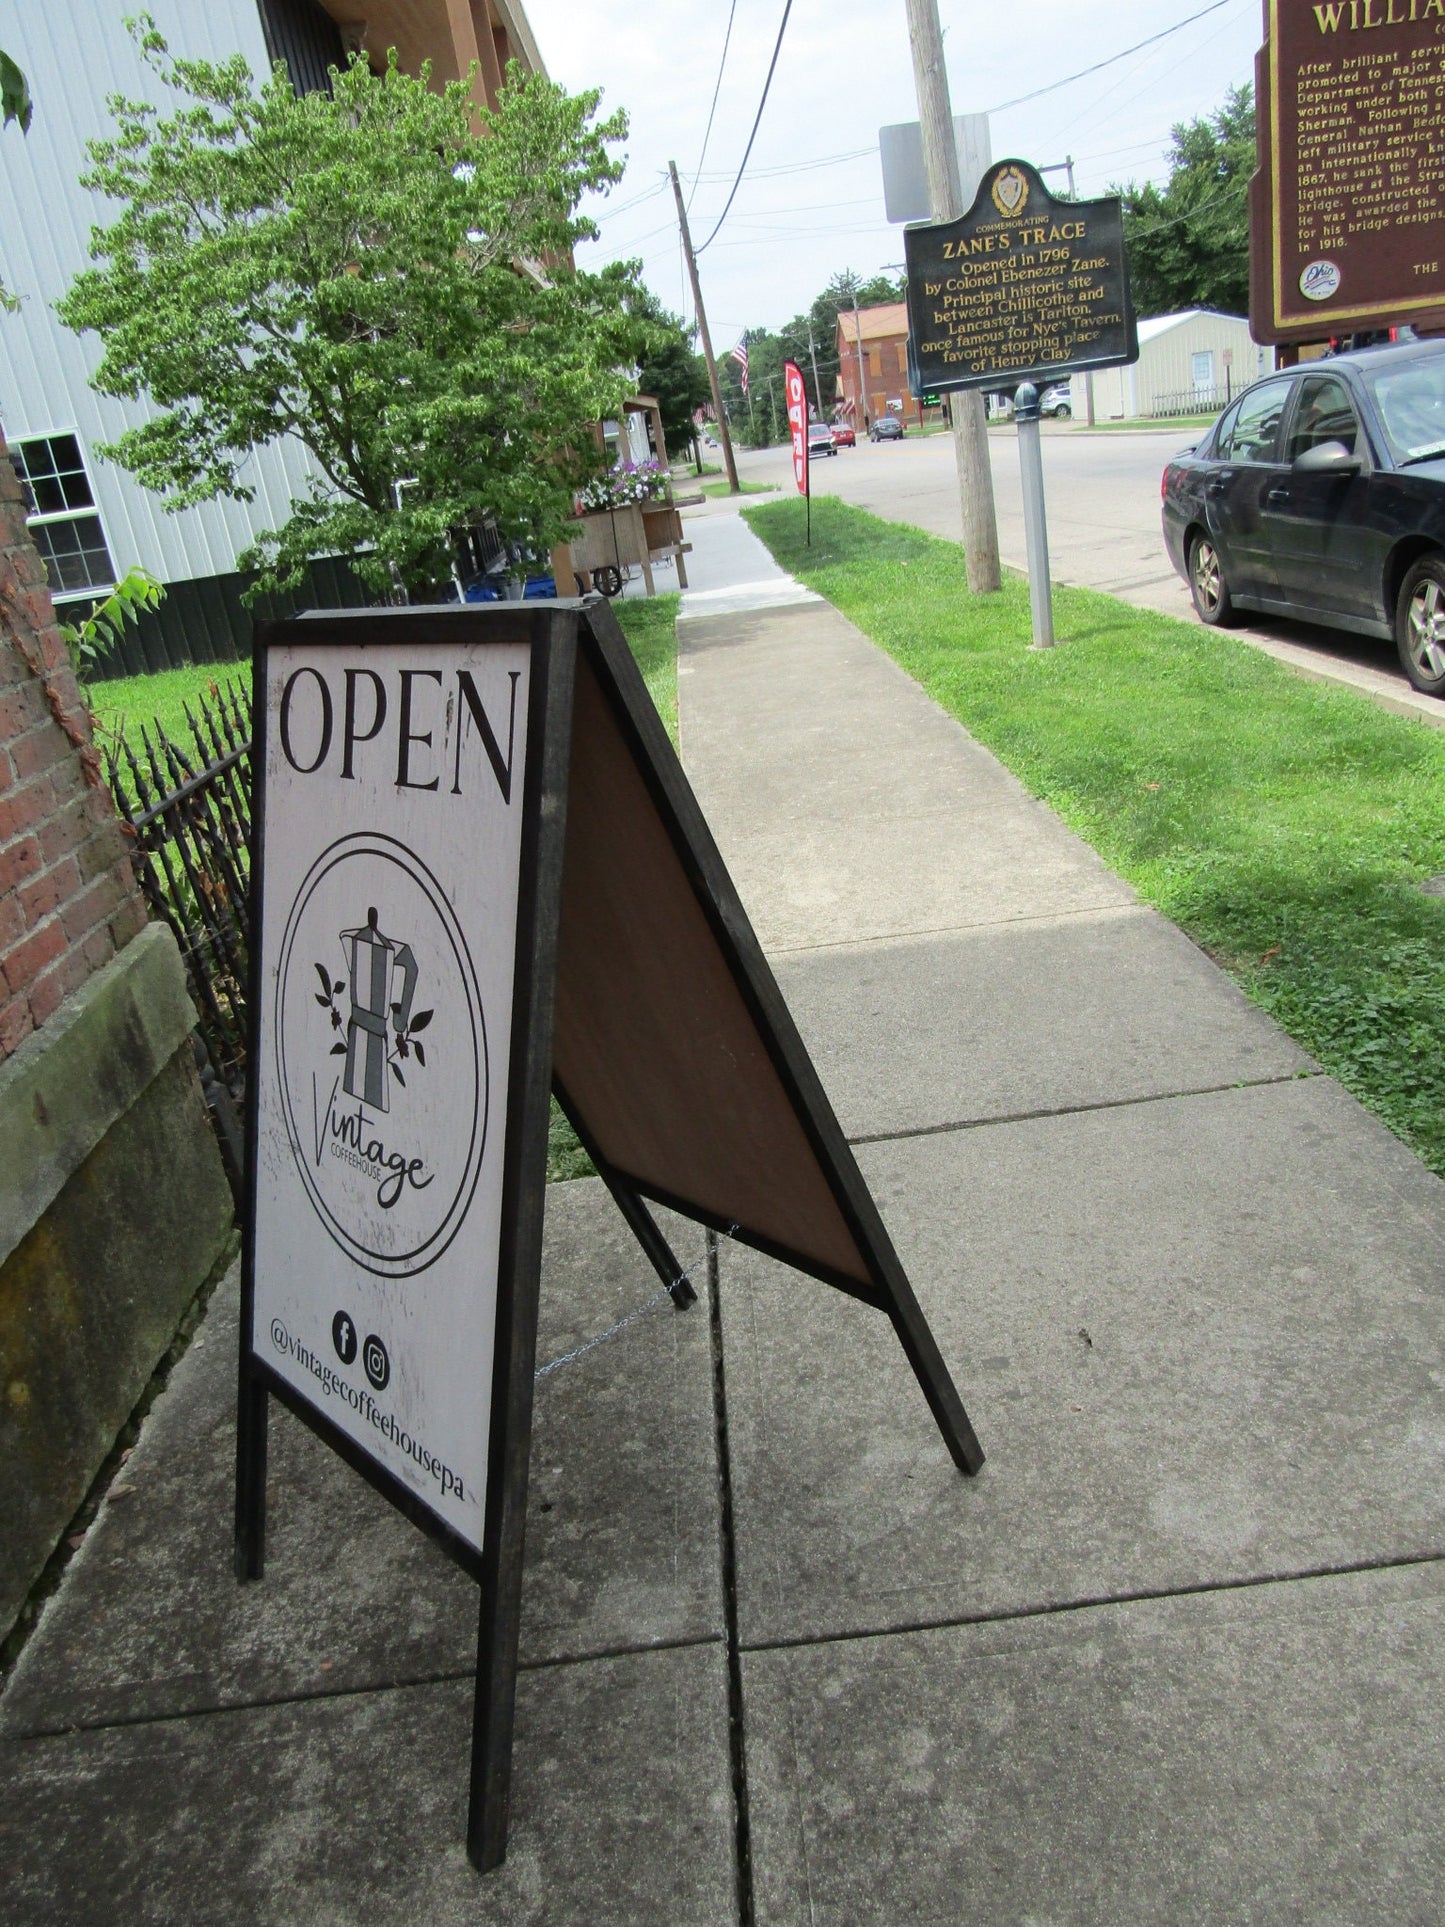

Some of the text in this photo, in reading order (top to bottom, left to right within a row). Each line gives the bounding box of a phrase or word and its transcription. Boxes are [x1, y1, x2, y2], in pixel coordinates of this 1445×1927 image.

[1298, 62, 1332, 76] After
[1343, 51, 1398, 70] brilliant
[1298, 71, 1359, 92] promoted
[1368, 70, 1381, 80] to
[1392, 62, 1431, 76] major
[1298, 84, 1375, 104] Department
[1381, 79, 1394, 92] of
[1298, 102, 1348, 118] working
[1356, 96, 1392, 110] under
[1399, 89, 1428, 103] both
[1298, 102, 1442, 132] Sherman. Following a
[1298, 128, 1348, 146] General
[1359, 122, 1402, 137] Nathan
[1298, 146, 1320, 160] left
[1328, 140, 1379, 156] military
[1387, 131, 1433, 146] service
[1298, 163, 1312, 174] an
[1322, 147, 1417, 170] internationally
[1333, 172, 1348, 182] he
[1354, 165, 1382, 178] sank
[1390, 162, 1409, 173] the
[1298, 182, 1364, 201] lighthouse
[1370, 178, 1382, 190] at
[1391, 176, 1410, 186] the
[1352, 185, 1429, 206] constructed
[976, 216, 1049, 234] COMMEMORATING
[1298, 198, 1438, 226] He was awarded the
[943, 222, 1086, 260] ZANE'S TRACE
[1298, 229, 1316, 240] for
[1323, 225, 1341, 236] his
[1348, 218, 1390, 232] bridge
[1299, 238, 1348, 253] in 1916.
[962, 247, 1070, 276] Opened in 1796
[1306, 264, 1334, 282] Ohio
[1413, 262, 1439, 275] THE
[925, 257, 1110, 296] by Colonel Ebenezer Zane.
[934, 286, 1104, 324] between Chillicothe and
[944, 276, 1092, 308] Principal historic site
[949, 315, 1018, 335] Lancaster
[1022, 311, 1033, 324] is
[922, 340, 952, 353] once
[956, 332, 1004, 348] famous
[1008, 326, 1029, 338] for
[1032, 322, 1068, 336] Nye's
[944, 331, 1100, 363] favorite stopping place
[971, 348, 1074, 372] of Henry Clay.
[280, 667, 521, 806] OPEN
[312, 1072, 435, 1209] Vintage
[330, 1142, 381, 1182] COFFEEHOUSE
[270, 1318, 465, 1501] @vintagecoffeehousepa
